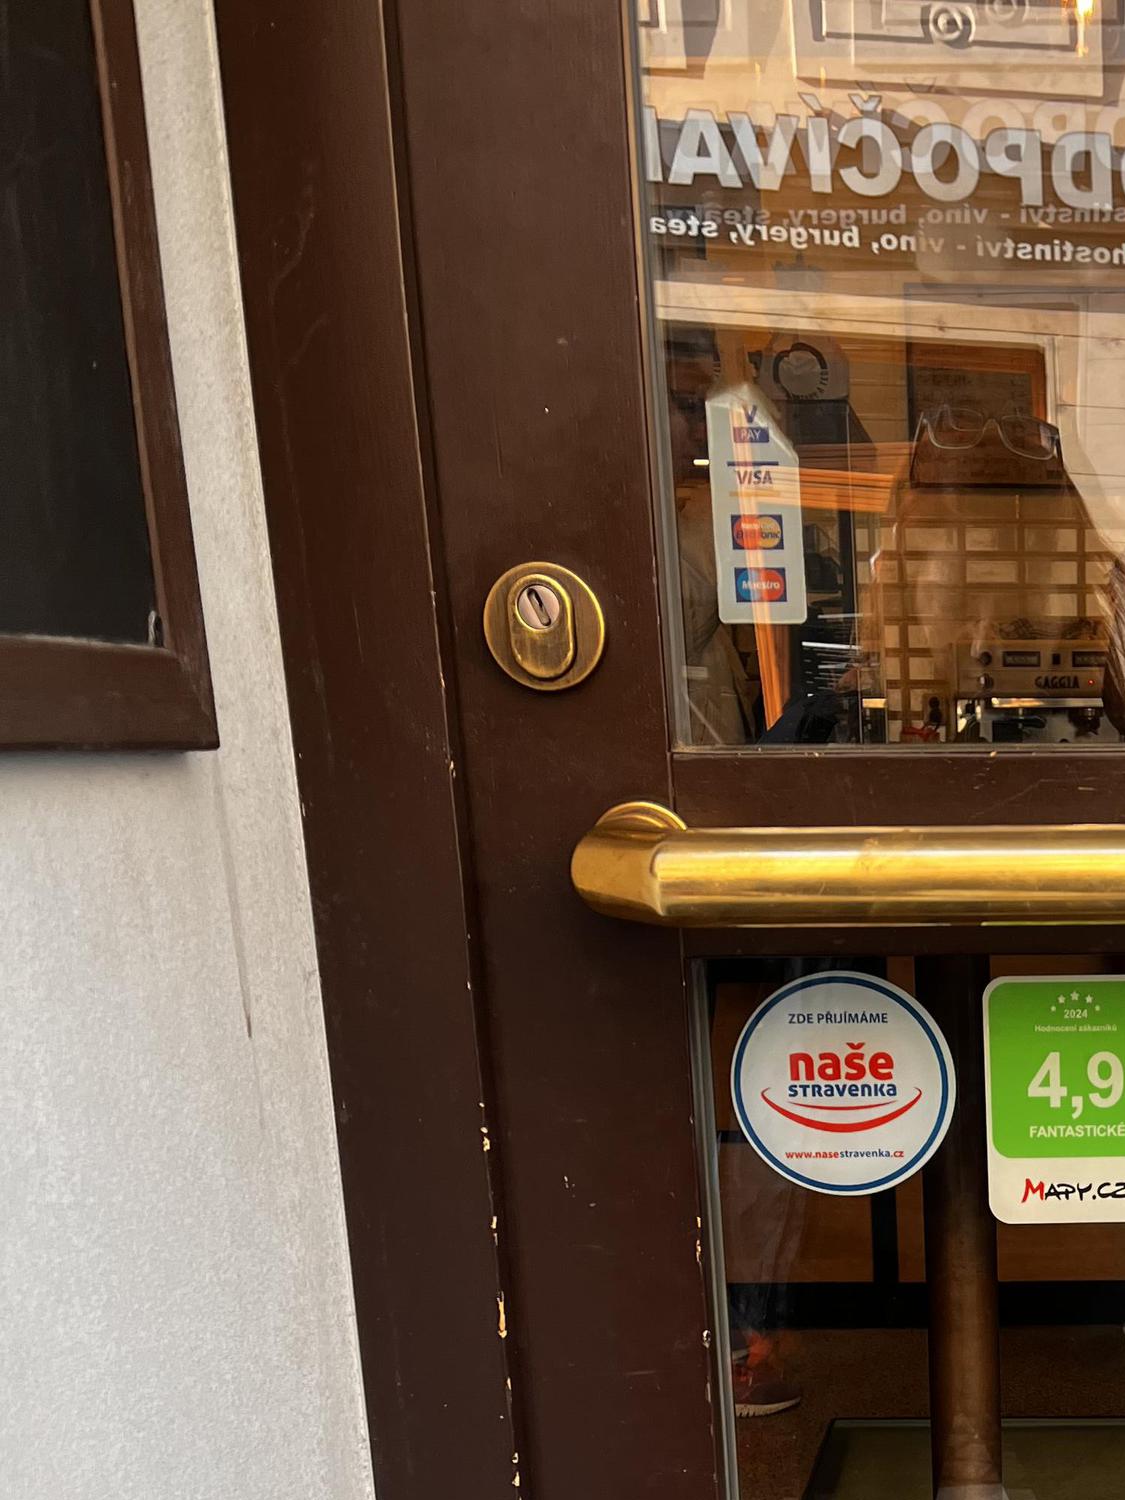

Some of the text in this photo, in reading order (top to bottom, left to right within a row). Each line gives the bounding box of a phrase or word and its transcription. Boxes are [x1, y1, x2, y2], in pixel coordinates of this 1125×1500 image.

[740, 429, 761, 439] PAY
[736, 470, 774, 485] VISA
[1034, 675, 1080, 690] GAGGIA
[787, 1010, 889, 1025] ZDE PŘIJÍMÁME
[1063, 1008, 1089, 1019] 2024
[788, 1041, 895, 1082] naše
[1026, 1050, 1125, 1120] 4,9
[784, 1149, 905, 1160] www.nasestravenka.cz
